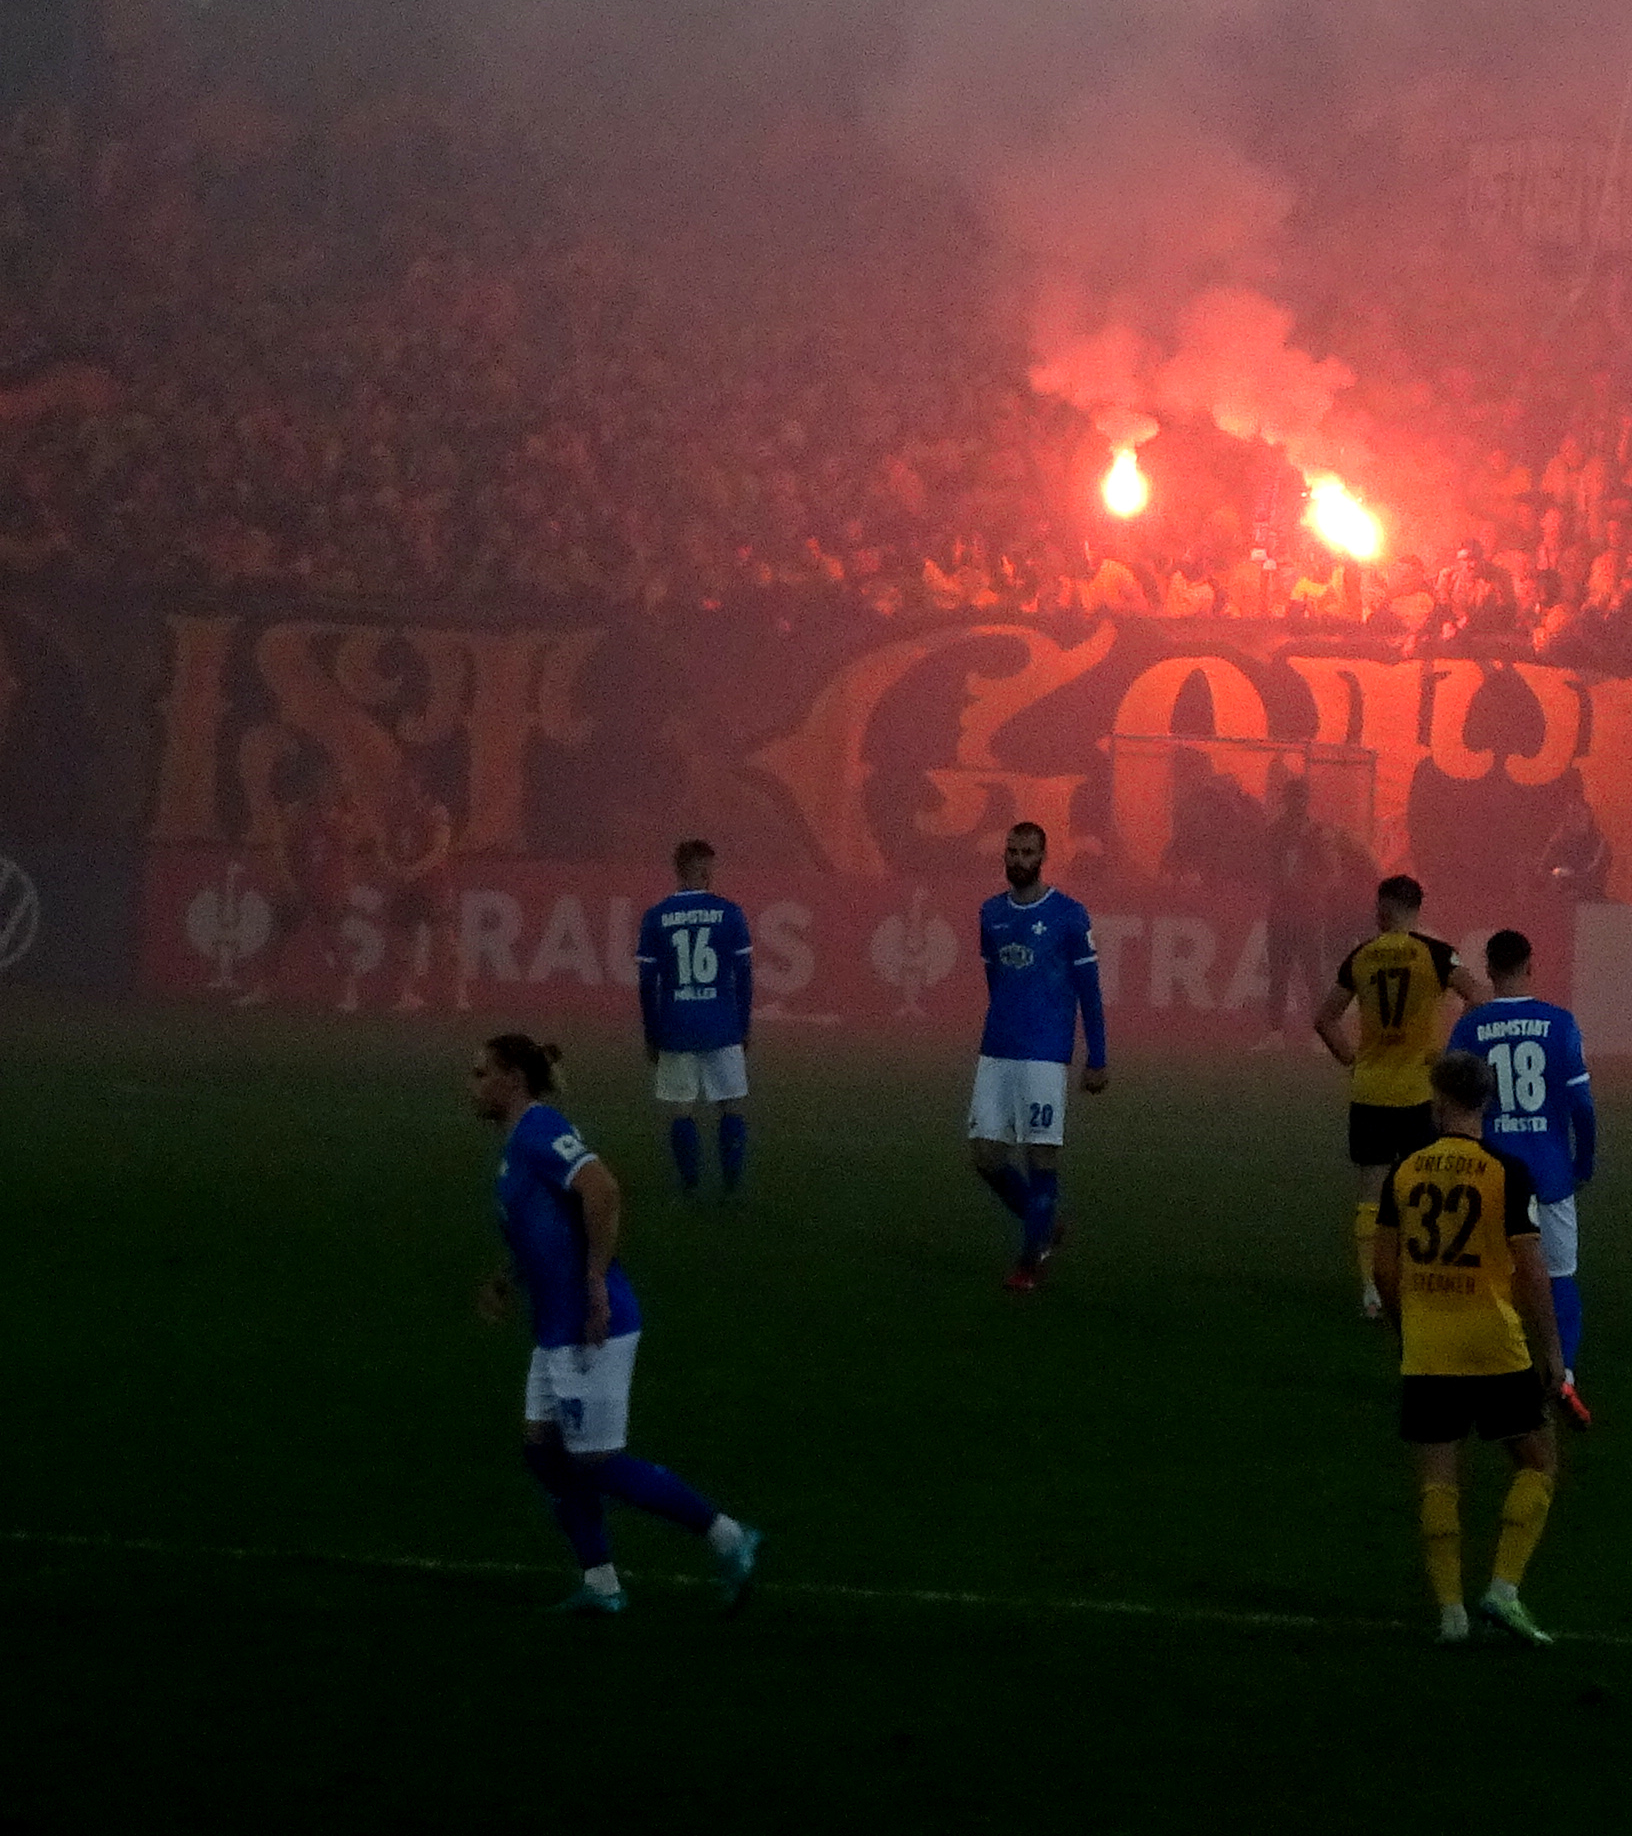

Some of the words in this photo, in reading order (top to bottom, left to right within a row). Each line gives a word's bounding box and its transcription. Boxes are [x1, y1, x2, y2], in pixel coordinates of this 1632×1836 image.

[671, 926, 718, 987] 16
[1369, 967, 1411, 1029] 17
[1487, 1040, 1548, 1113] 18
[1029, 1102, 1054, 1128] 20
[1407, 1182, 1481, 1267] 32
